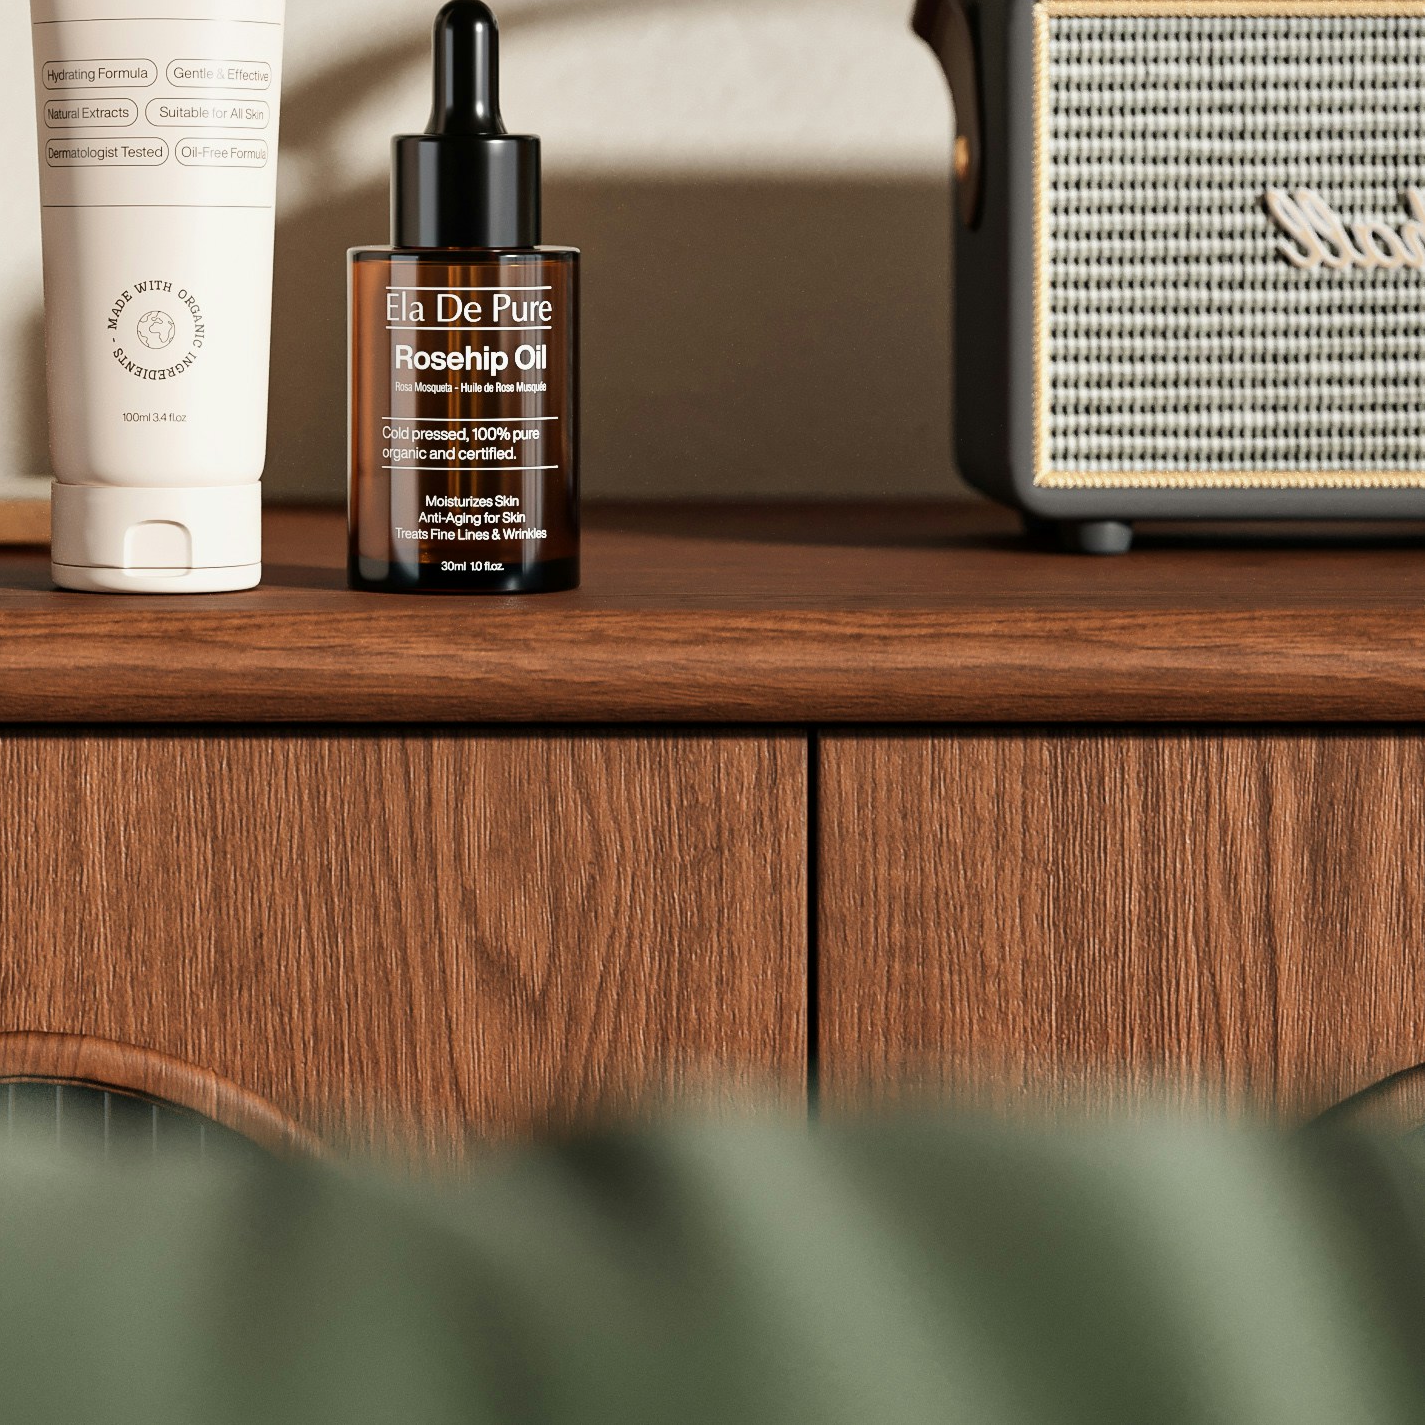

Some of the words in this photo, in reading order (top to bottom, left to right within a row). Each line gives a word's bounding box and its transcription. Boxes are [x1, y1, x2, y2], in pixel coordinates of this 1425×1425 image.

[47, 68, 95, 82] Hydrating
[98, 68, 148, 79] Formula
[173, 67, 213, 79] Gentle
[217, 69, 225, 79] &
[227, 69, 269, 82] Effective
[47, 108, 80, 119] Natural
[82, 107, 130, 118] Extracts
[159, 106, 209, 118] Suitable
[230, 108, 243, 119] All
[245, 108, 264, 120] Skin
[48, 147, 118, 160] Dermatologist
[121, 146, 163, 158] Tested
[181, 146, 228, 158] Oil-Free
[230, 148, 266, 159] Formula
[134, 280, 173, 293] WITH
[108, 291, 132, 330] MADE
[386, 291, 425, 322] Ela
[437, 293, 482, 323] De
[493, 293, 553, 322] Pure
[177, 289, 205, 348] ORGANIC
[112, 348, 197, 380] INGREDIENTS
[395, 345, 509, 376] Rosehip
[515, 344, 547, 370] Oil
[395, 382, 412, 392] Rosa
[414, 382, 453, 394] Mosqueta
[460, 383, 482, 393] Huile
[484, 383, 494, 393] de
[496, 382, 515, 393] Rose
[123, 413, 151, 422] 100ml
[152, 413, 167, 422] 3.4
[382, 426, 409, 440] Cold
[412, 428, 470, 444] pressed,
[472, 428, 510, 441] 100%
[513, 429, 540, 443] pure
[382, 447, 427, 463] organic
[430, 447, 456, 460] and
[458, 446, 517, 461] certified.
[425, 495, 494, 508] Moisturizes
[495, 495, 520, 507] Skin
[418, 512, 482, 526] Anti-Aging
[484, 512, 500, 524] for
[502, 512, 526, 523] Skin
[395, 527, 428, 540] Treats
[430, 528, 455, 540] Fine
[458, 528, 490, 541] Lines
[492, 529, 501, 541] &
[503, 528, 547, 540] Wrinkles
[441, 561, 467, 572] 30ml
